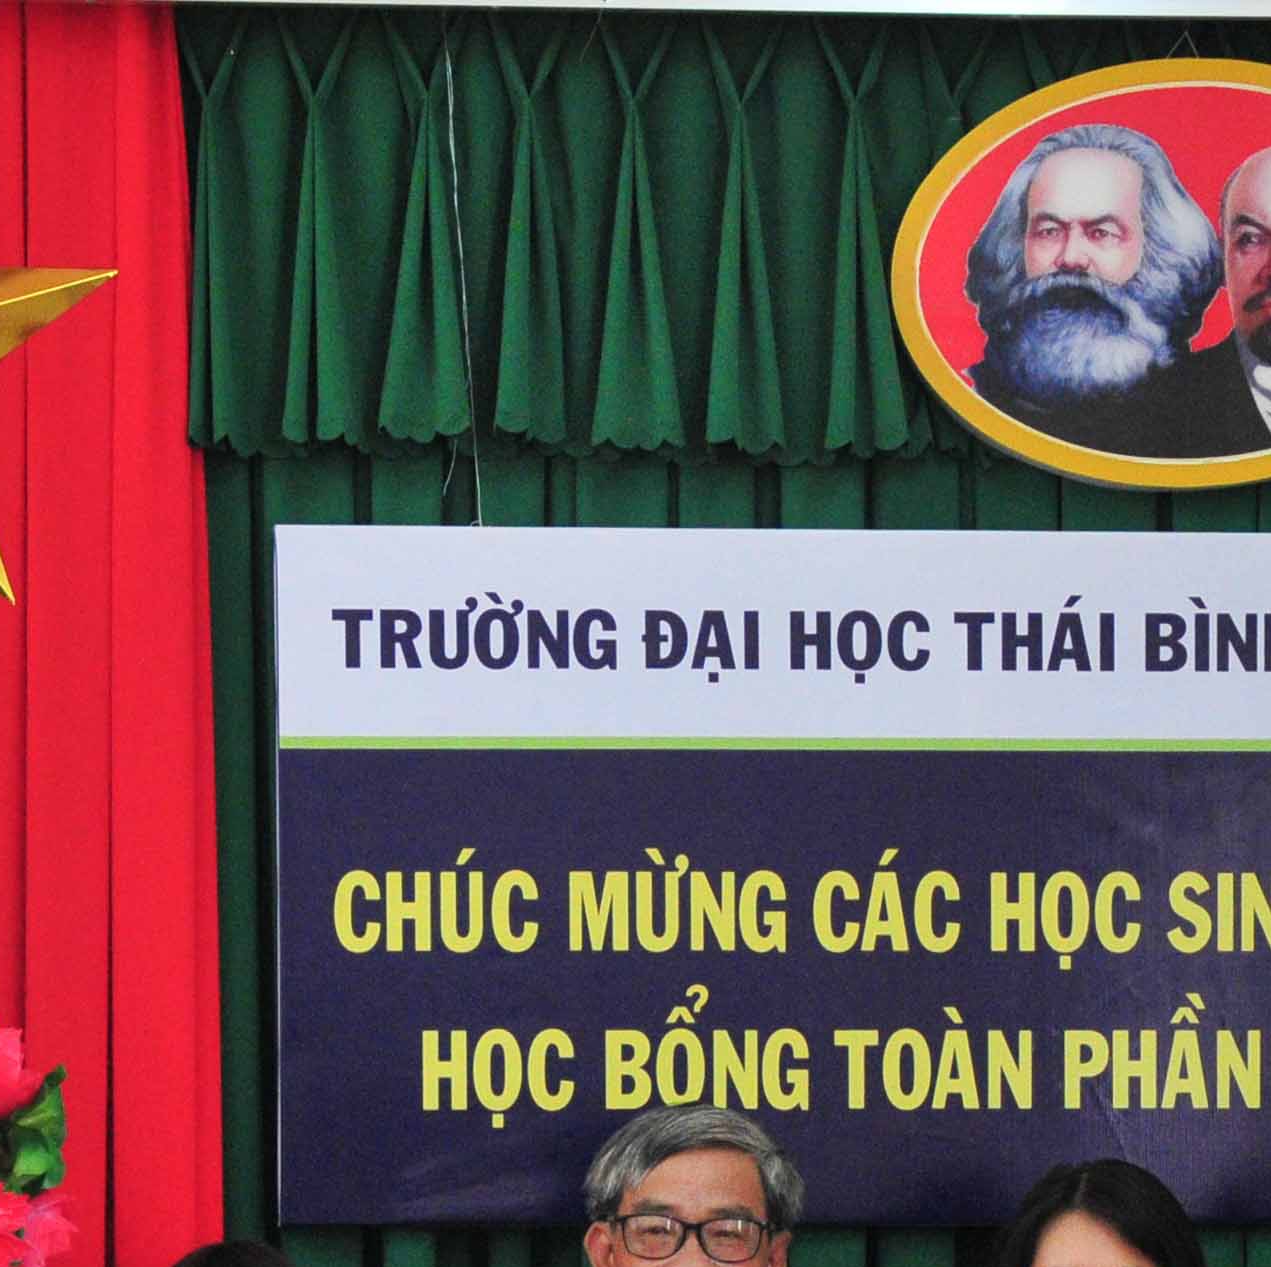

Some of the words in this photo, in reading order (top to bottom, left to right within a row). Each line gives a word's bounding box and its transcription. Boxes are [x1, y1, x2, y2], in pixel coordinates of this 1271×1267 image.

[332, 592, 616, 669] TRƯỜNG
[642, 610, 759, 682] ĐẠI
[790, 611, 929, 683] HỌC
[954, 596, 1114, 671] THÁI
[334, 848, 538, 953] CHÚC
[569, 848, 786, 953] MỪNG
[813, 848, 960, 953] CÁC
[991, 871, 1141, 970] HỌC
[422, 1028, 574, 1128] HỌC
[605, 984, 809, 1110] BỔNG
[834, 1007, 1032, 1110] TOÀN
[1064, 993, 1261, 1109] PHẦN
